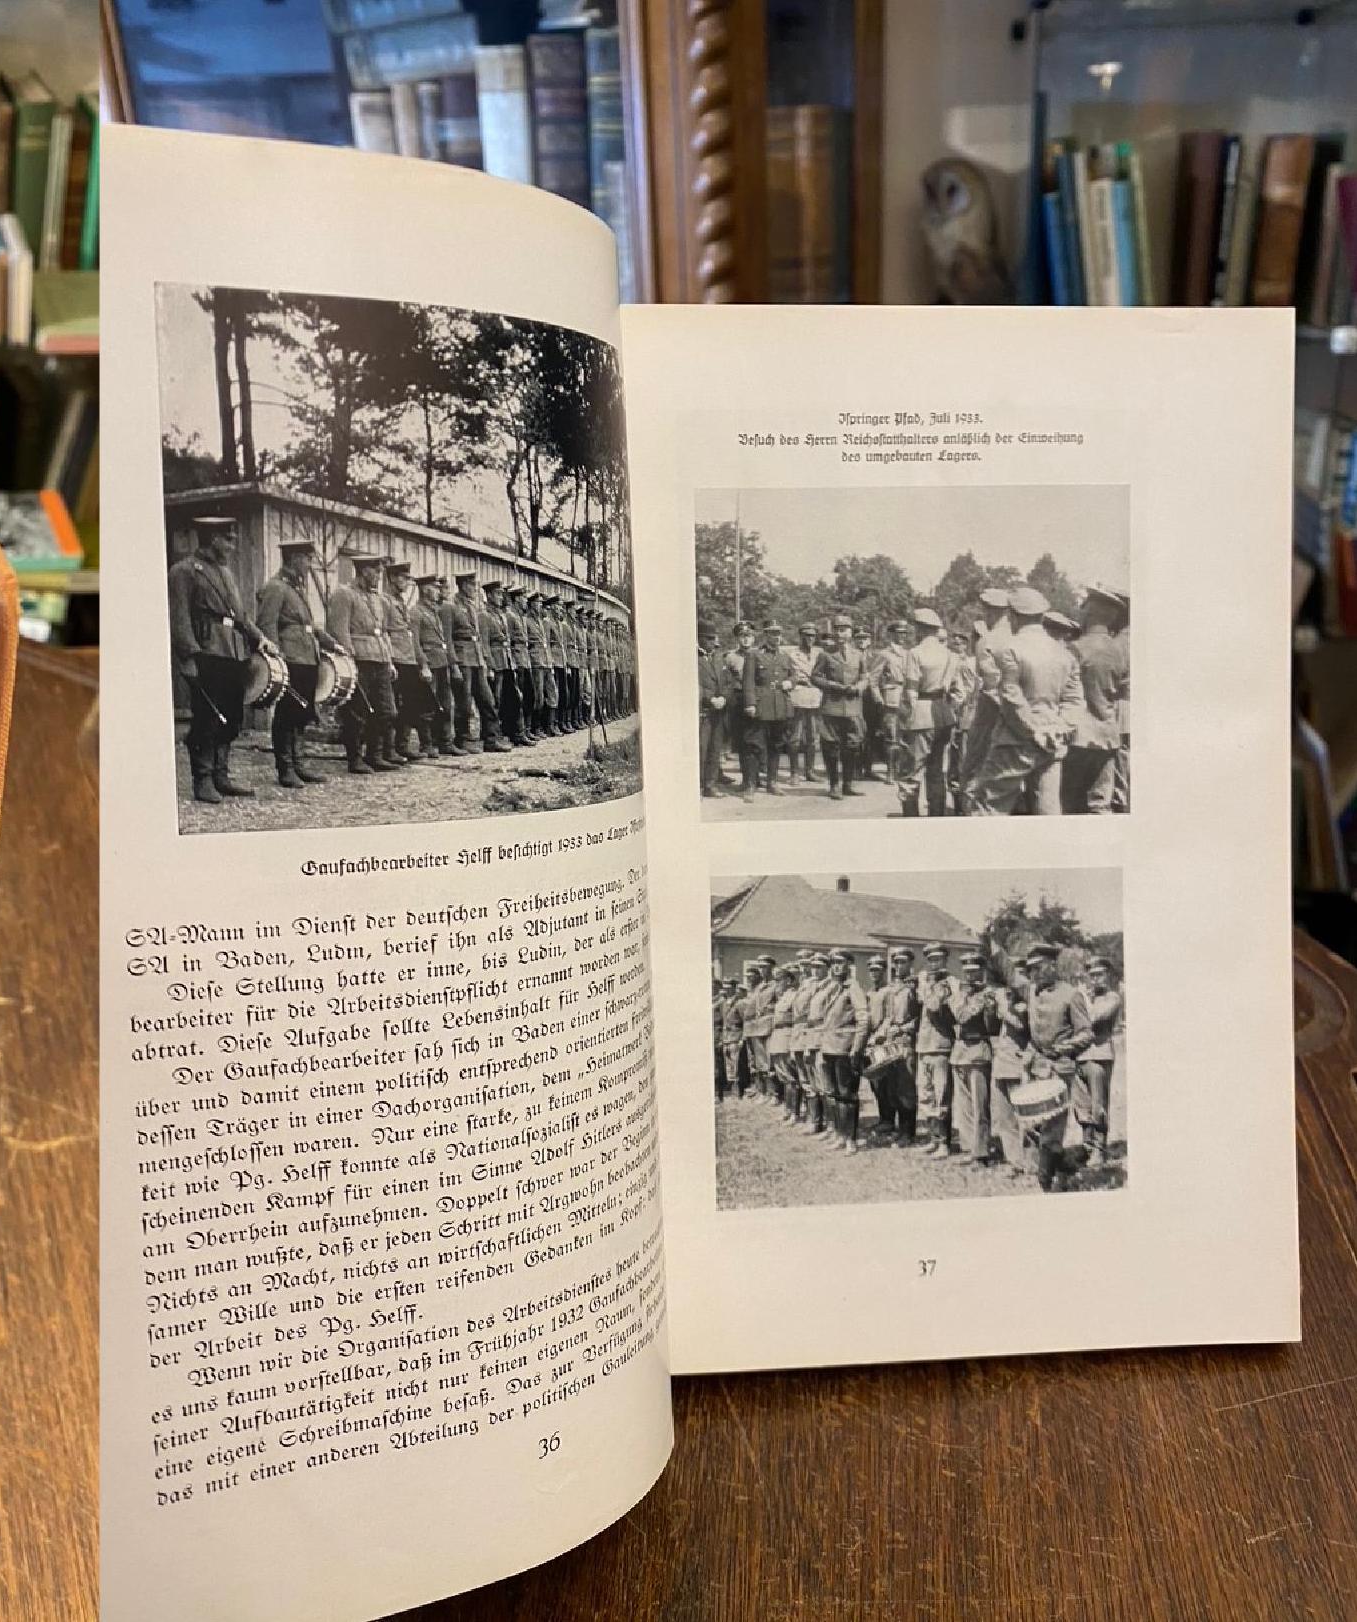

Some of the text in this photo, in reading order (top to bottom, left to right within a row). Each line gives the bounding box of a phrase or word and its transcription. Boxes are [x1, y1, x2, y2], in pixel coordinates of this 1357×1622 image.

[779, 433, 800, 446] des
[995, 432, 1013, 445] der
[841, 450, 860, 463] des
[300, 853, 449, 877] Gaufachbearbeiter
[456, 847, 492, 867] Helff
[558, 836, 582, 852] 1933
[127, 911, 588, 976] SA in Baden, Ludin, berief ihn als Adjutant
[256, 921, 280, 939] im
[366, 913, 396, 929] der
[130, 966, 573, 1033] bearbeiter für die ernannt
[236, 975, 324, 996] Stellung
[336, 969, 386, 992] hatte
[398, 968, 415, 981] er
[427, 961, 471, 978] inne,
[482, 952, 507, 971] bis
[518, 942, 566, 964] Ludin,
[132, 1040, 204, 1061] abtrat.
[284, 1023, 370, 1048] Aufgabe
[442, 995, 550, 1029] Lebensinhalt
[559, 989, 579, 1011] für
[172, 1067, 214, 1085] Der
[224, 1048, 406, 1080] Gaufachbearbeiter
[488, 1032, 504, 1049] in
[512, 1021, 564, 1043] Baden
[135, 1081, 366, 1117] über und damit einem
[206, 1069, 571, 1137] Träger in einer dem
[294, 1087, 592, 1153] waren. Nur eine zu keinem
[142, 1148, 436, 1201] keit wie Pg. Helff konnte als
[266, 1137, 575, 1211] Kampf für einen im Sinne Adolf
[143, 1242, 175, 1257] am
[186, 1220, 288, 1249] Oberrhein
[298, 1207, 427, 1234] aufzunehmen.
[436, 1185, 508, 1213] Doppelt
[144, 1203, 535, 1285] dem man wußte, daß er jeden Schritt mit
[146, 1256, 430, 1313] Nichts an Macht, nichts an
[219, 1233, 592, 1325] Wille und die reifenden Gedanken
[918, 1259, 937, 1277] 37
[150, 1304, 423, 1368] der Arbeit des Pg. Helff.
[151, 1304, 583, 1424] es uns kaum daß im Frühjahr 1932
[187, 1314, 495, 1387] Wenn wir die des
[220, 1331, 588, 1435] Aufbautätigkeit nicht nur keinen eigenen
[155, 1360, 574, 1480] eine eigene Das zur
[538, 1431, 561, 1460] 36
[157, 1408, 514, 1506] das mit einer anderen Abteilung der
